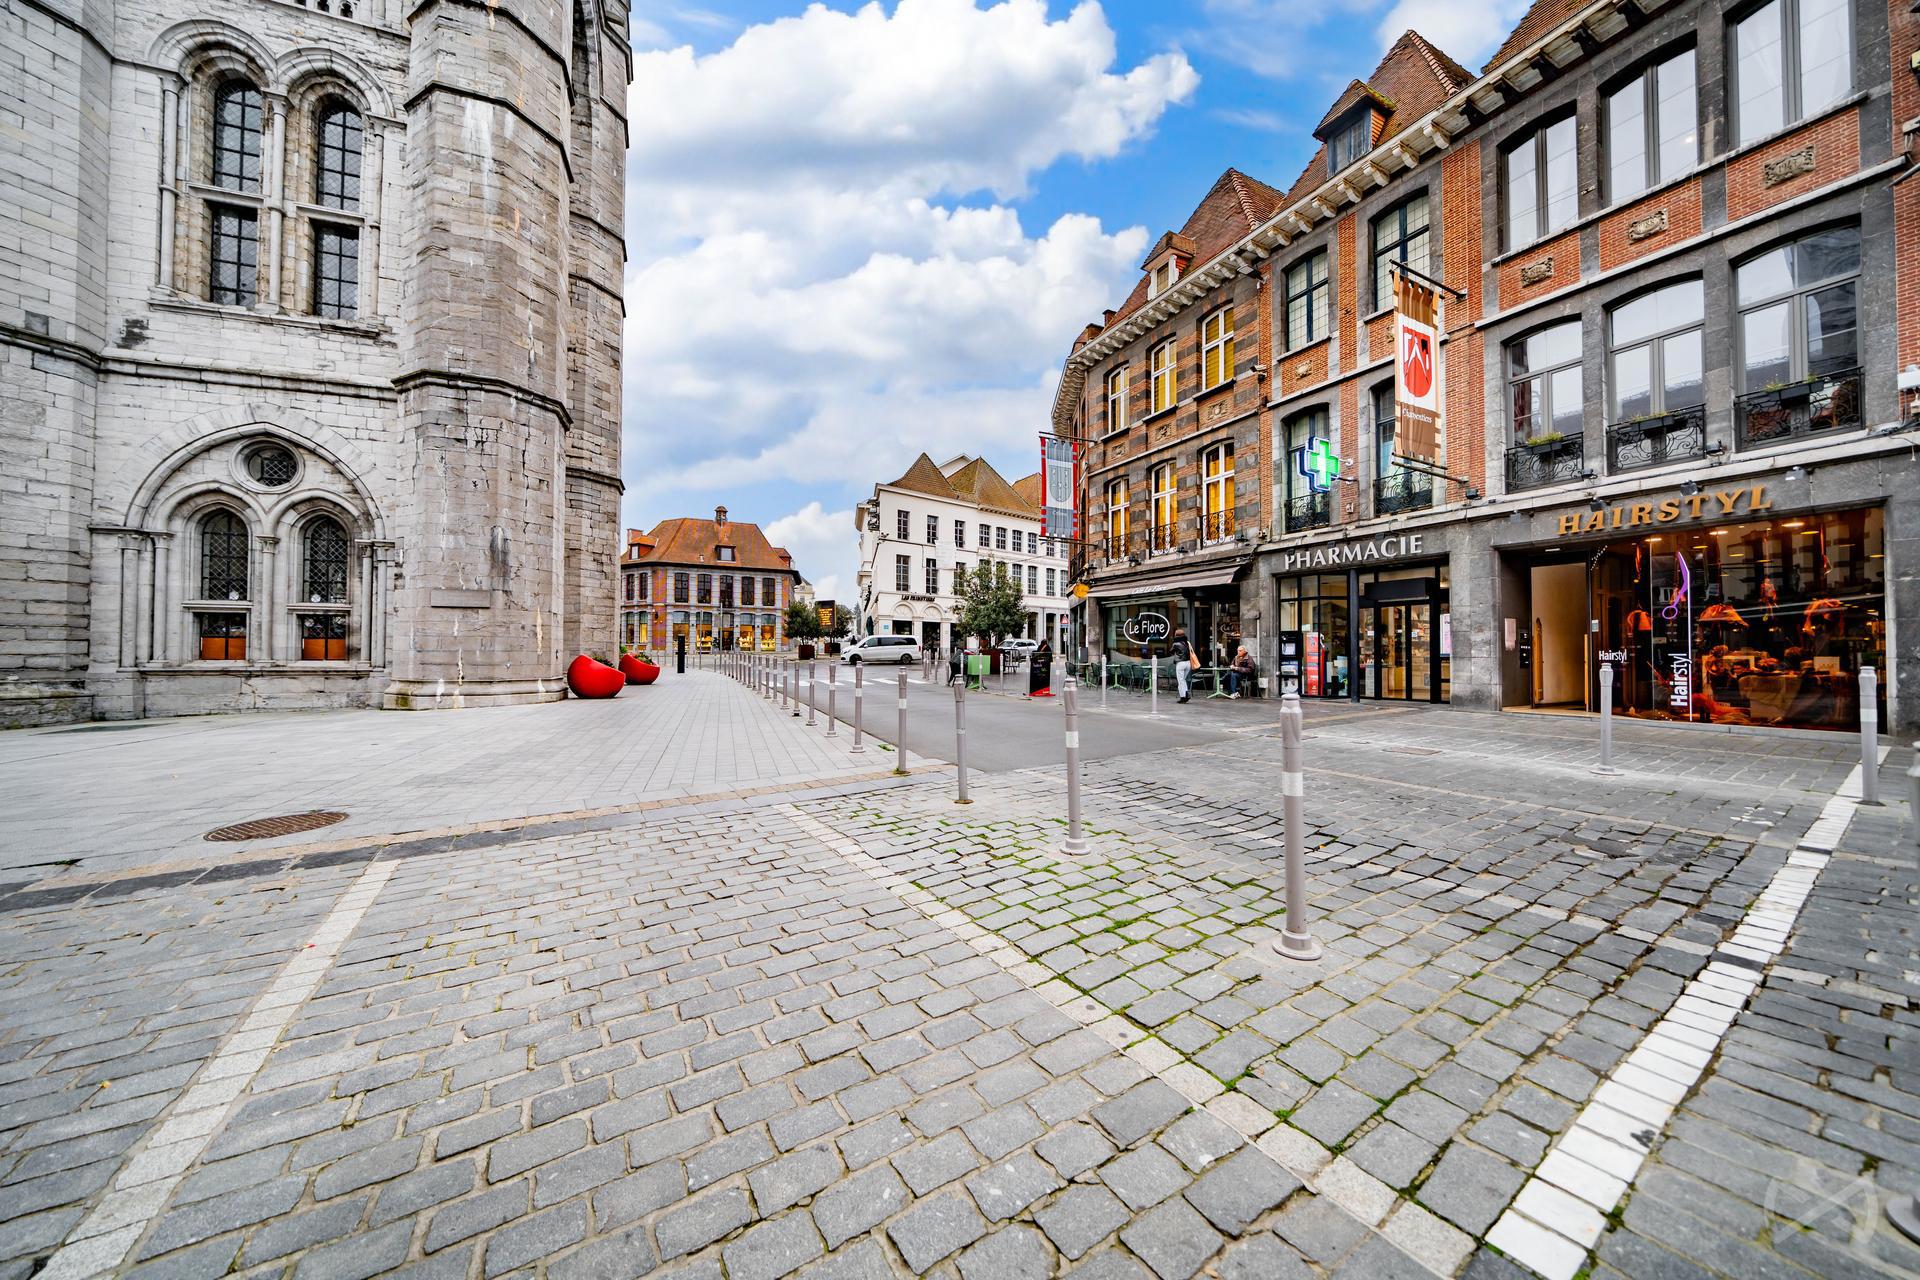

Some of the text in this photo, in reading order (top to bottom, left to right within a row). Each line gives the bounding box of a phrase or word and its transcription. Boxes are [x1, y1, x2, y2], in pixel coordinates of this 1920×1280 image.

[1557, 486, 1773, 536] HAIRSTYL
[1284, 534, 1423, 570] PHARMACIE
[1129, 620, 1165, 635] Le Flore
[1598, 649, 1627, 664] Hairstyl
[1667, 653, 1692, 706] Hairstyl
